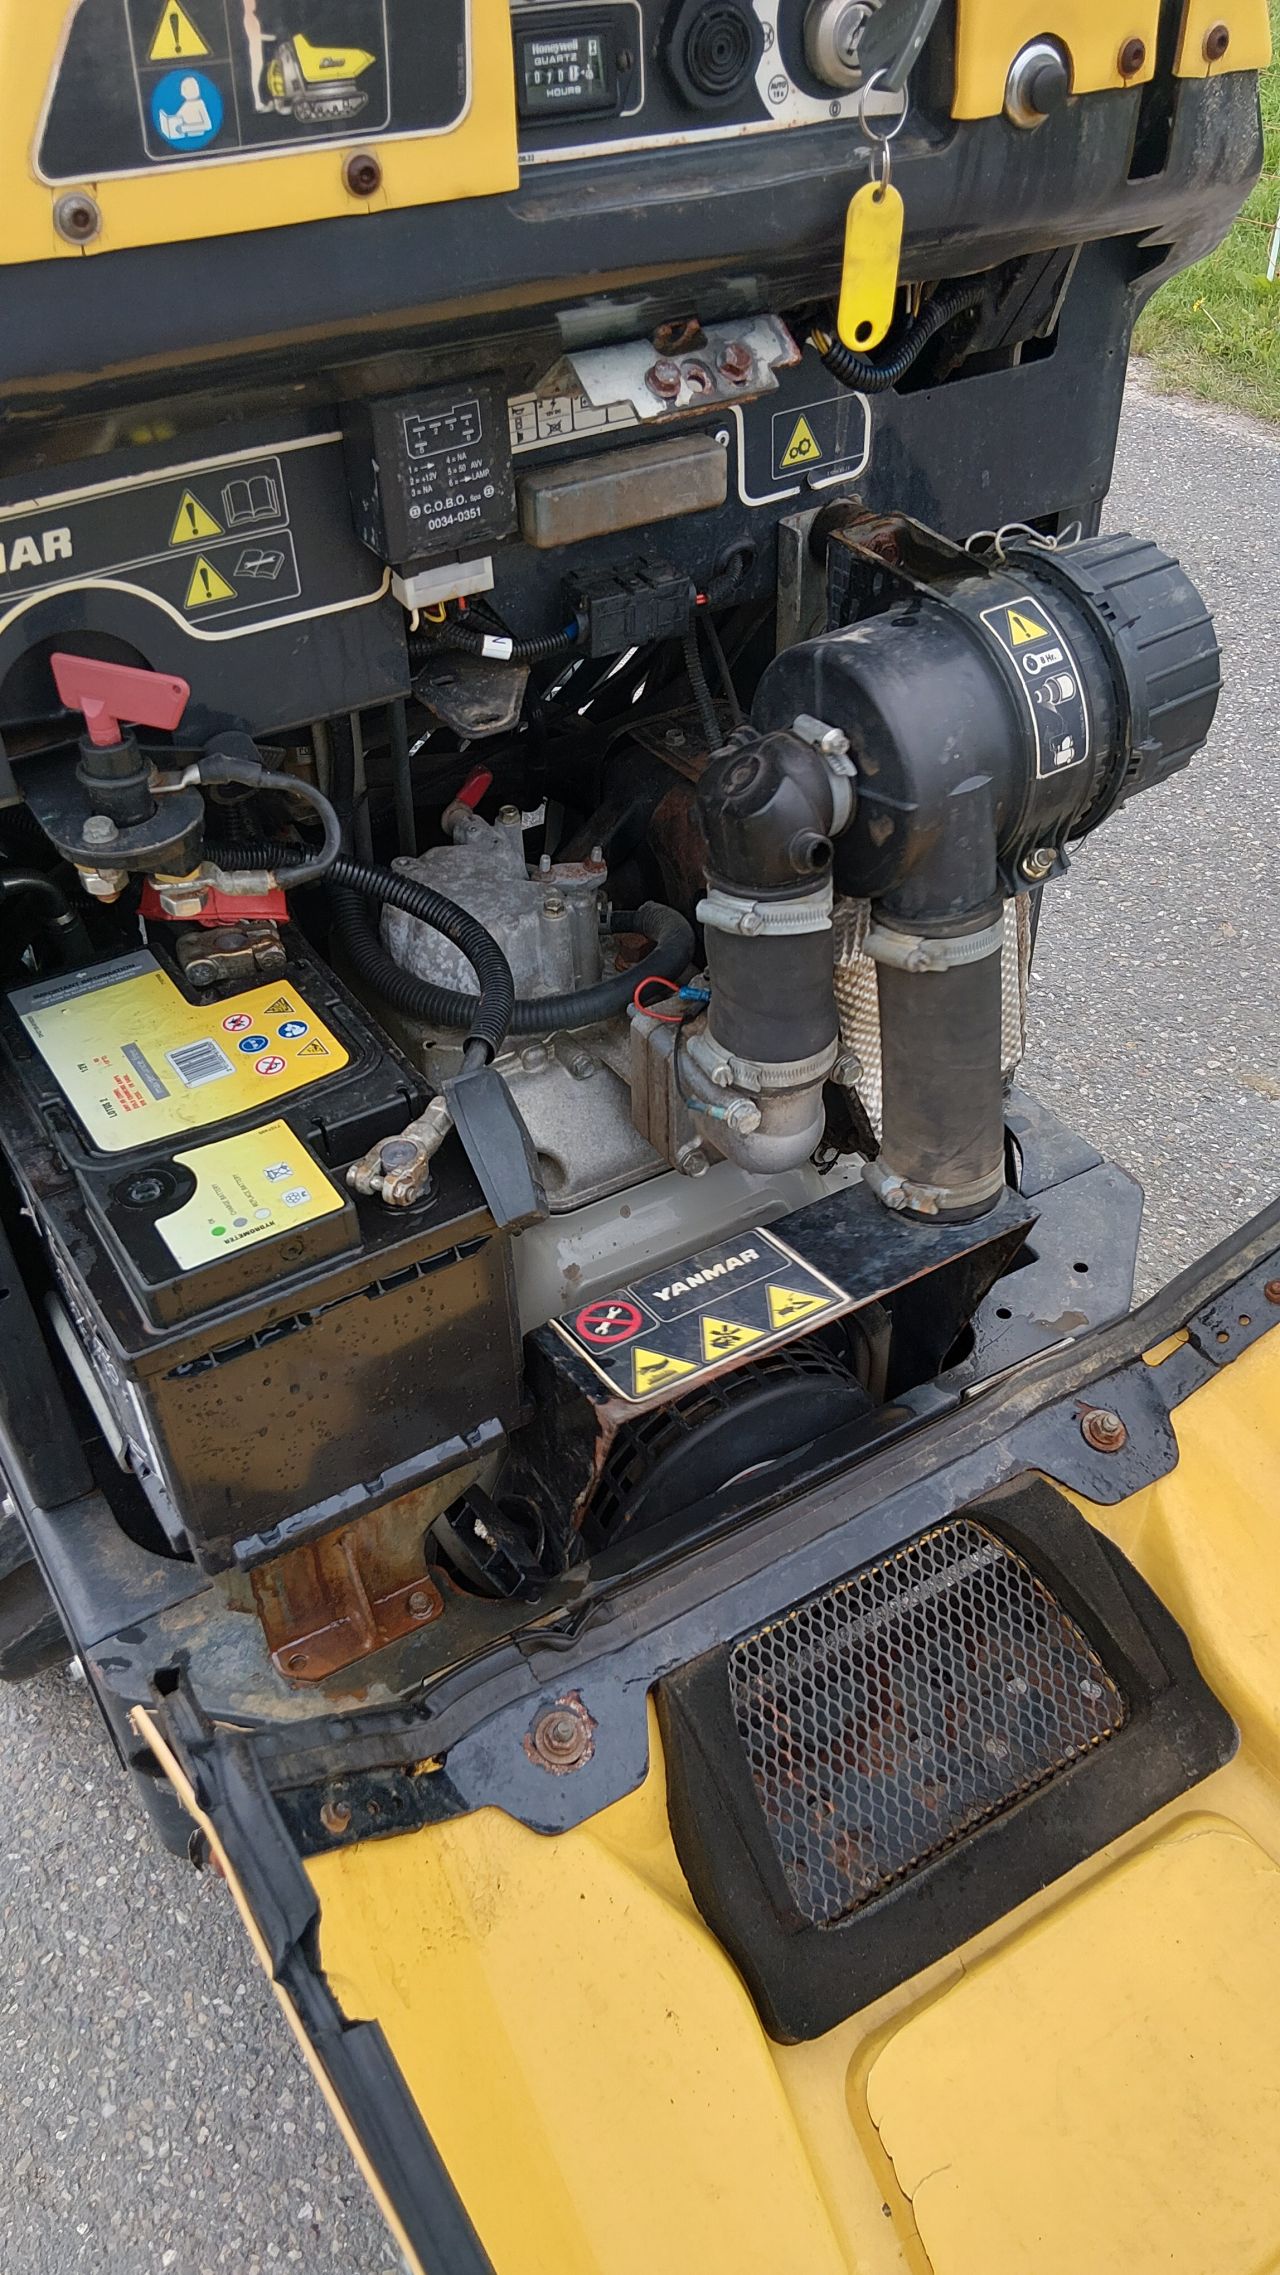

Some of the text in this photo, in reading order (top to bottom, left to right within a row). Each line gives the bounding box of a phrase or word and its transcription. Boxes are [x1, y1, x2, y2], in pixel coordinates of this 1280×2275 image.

[532, 39, 578, 55] Honeywell
[534, 52, 577, 66] QUARTZ
[546, 85, 582, 98] HOURS
[771, 81, 787, 89] AUTO
[471, 468, 490, 480] LAMP
[423, 494, 468, 514] C.O.B.O.
[428, 507, 481, 530] 0034-0351
[33, 982, 79, 999] IMPORTANT
[80, 964, 136, 981] INFORMATION
[224, 1220, 276, 1244] HYDROMETER
[652, 1248, 761, 1301] YANMAR
